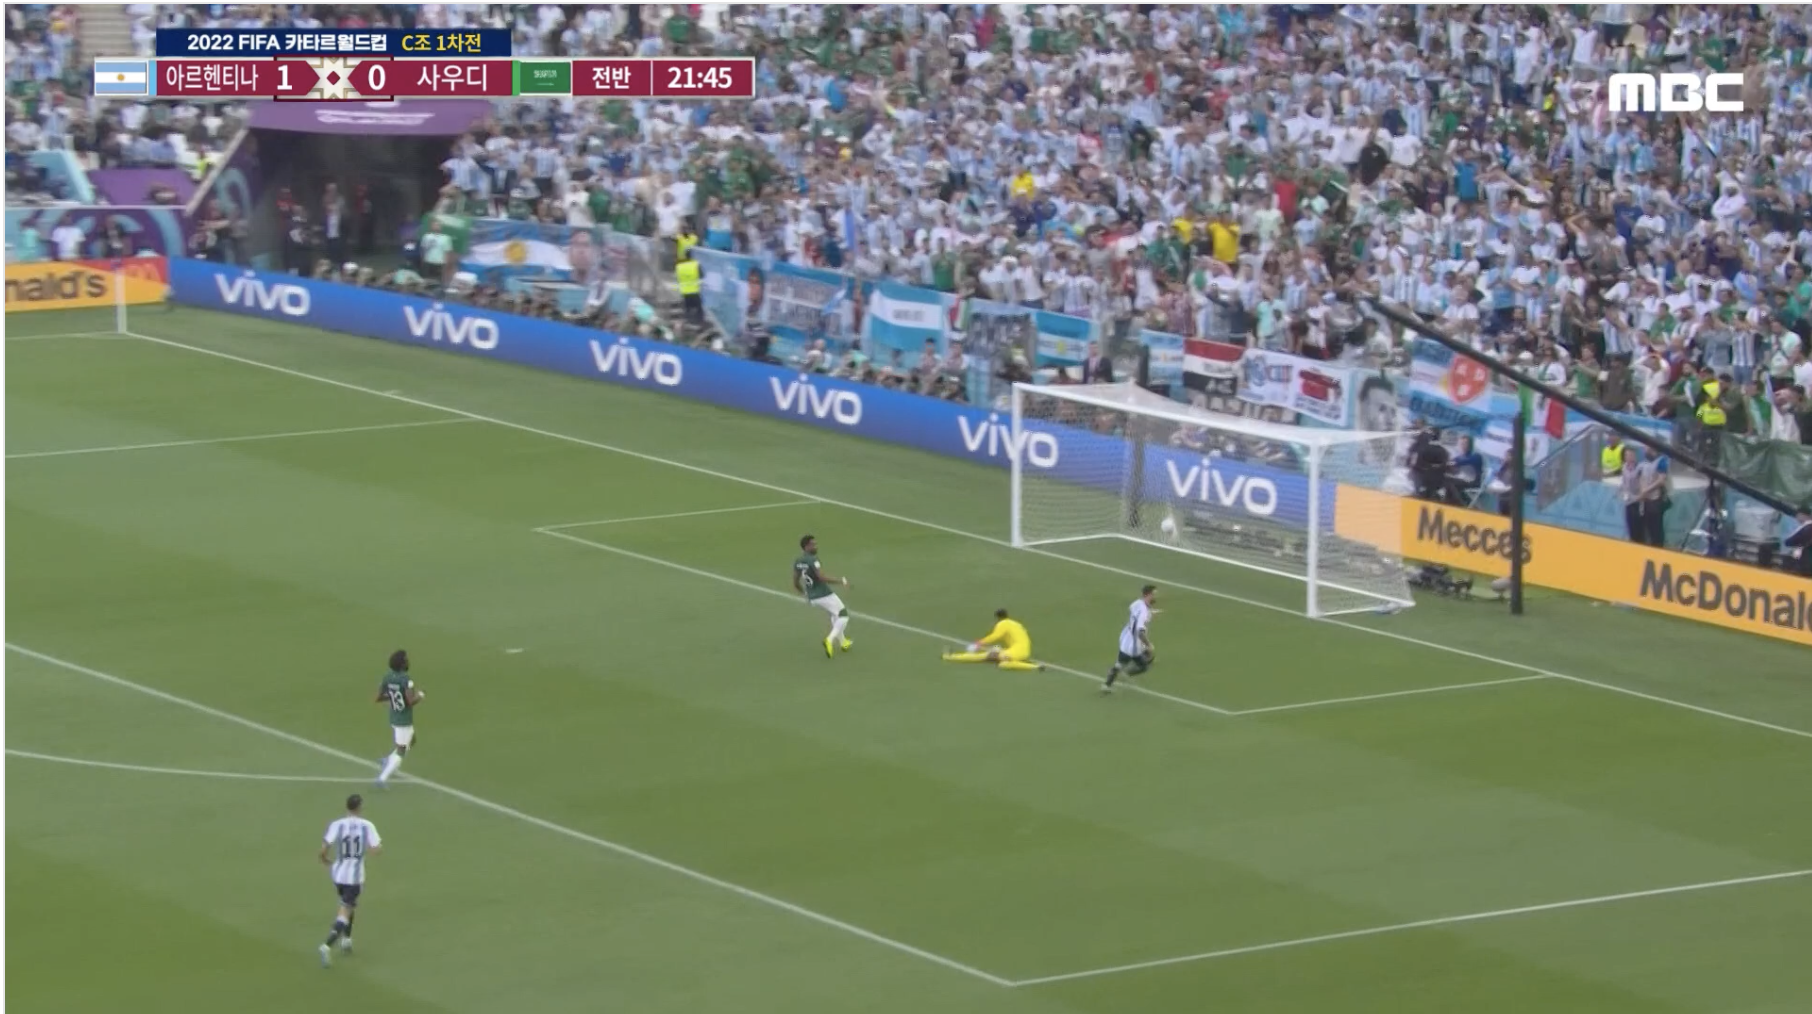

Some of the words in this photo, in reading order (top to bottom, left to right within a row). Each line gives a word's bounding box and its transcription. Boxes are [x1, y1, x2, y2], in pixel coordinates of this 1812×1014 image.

[214, 270, 311, 316] vivo
[403, 303, 499, 350] vivo
[588, 337, 683, 386] vivo
[769, 373, 863, 425] vivo
[957, 412, 1059, 468] vivo
[1166, 458, 1278, 516] vivo
[1639, 558, 1812, 635] McDonal
[388, 690, 405, 712] 13
[341, 834, 362, 860] 11
